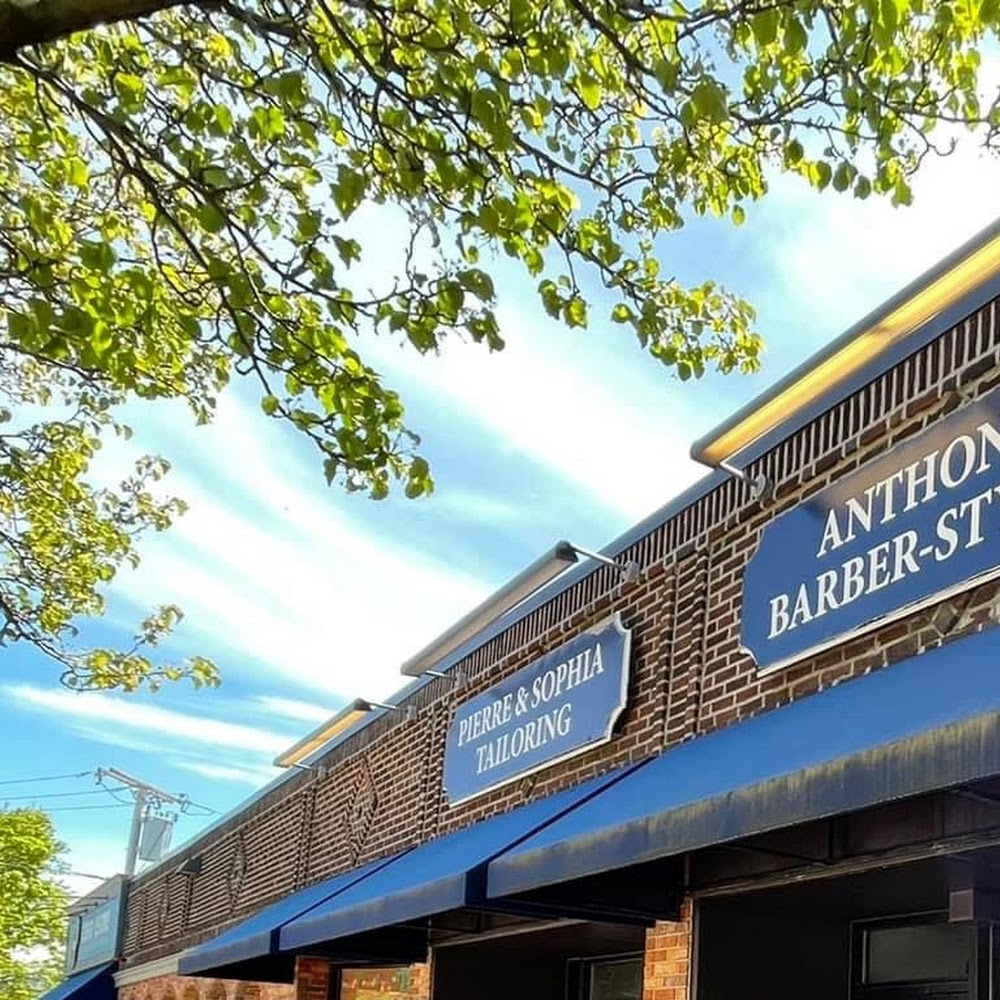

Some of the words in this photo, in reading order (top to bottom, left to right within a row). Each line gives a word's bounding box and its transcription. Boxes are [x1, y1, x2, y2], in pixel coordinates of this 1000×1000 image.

[457, 692, 513, 747] PIERRE
[515, 686, 529, 717] &
[531, 642, 605, 708] SOPHIA
[475, 702, 572, 774] TAILORING
